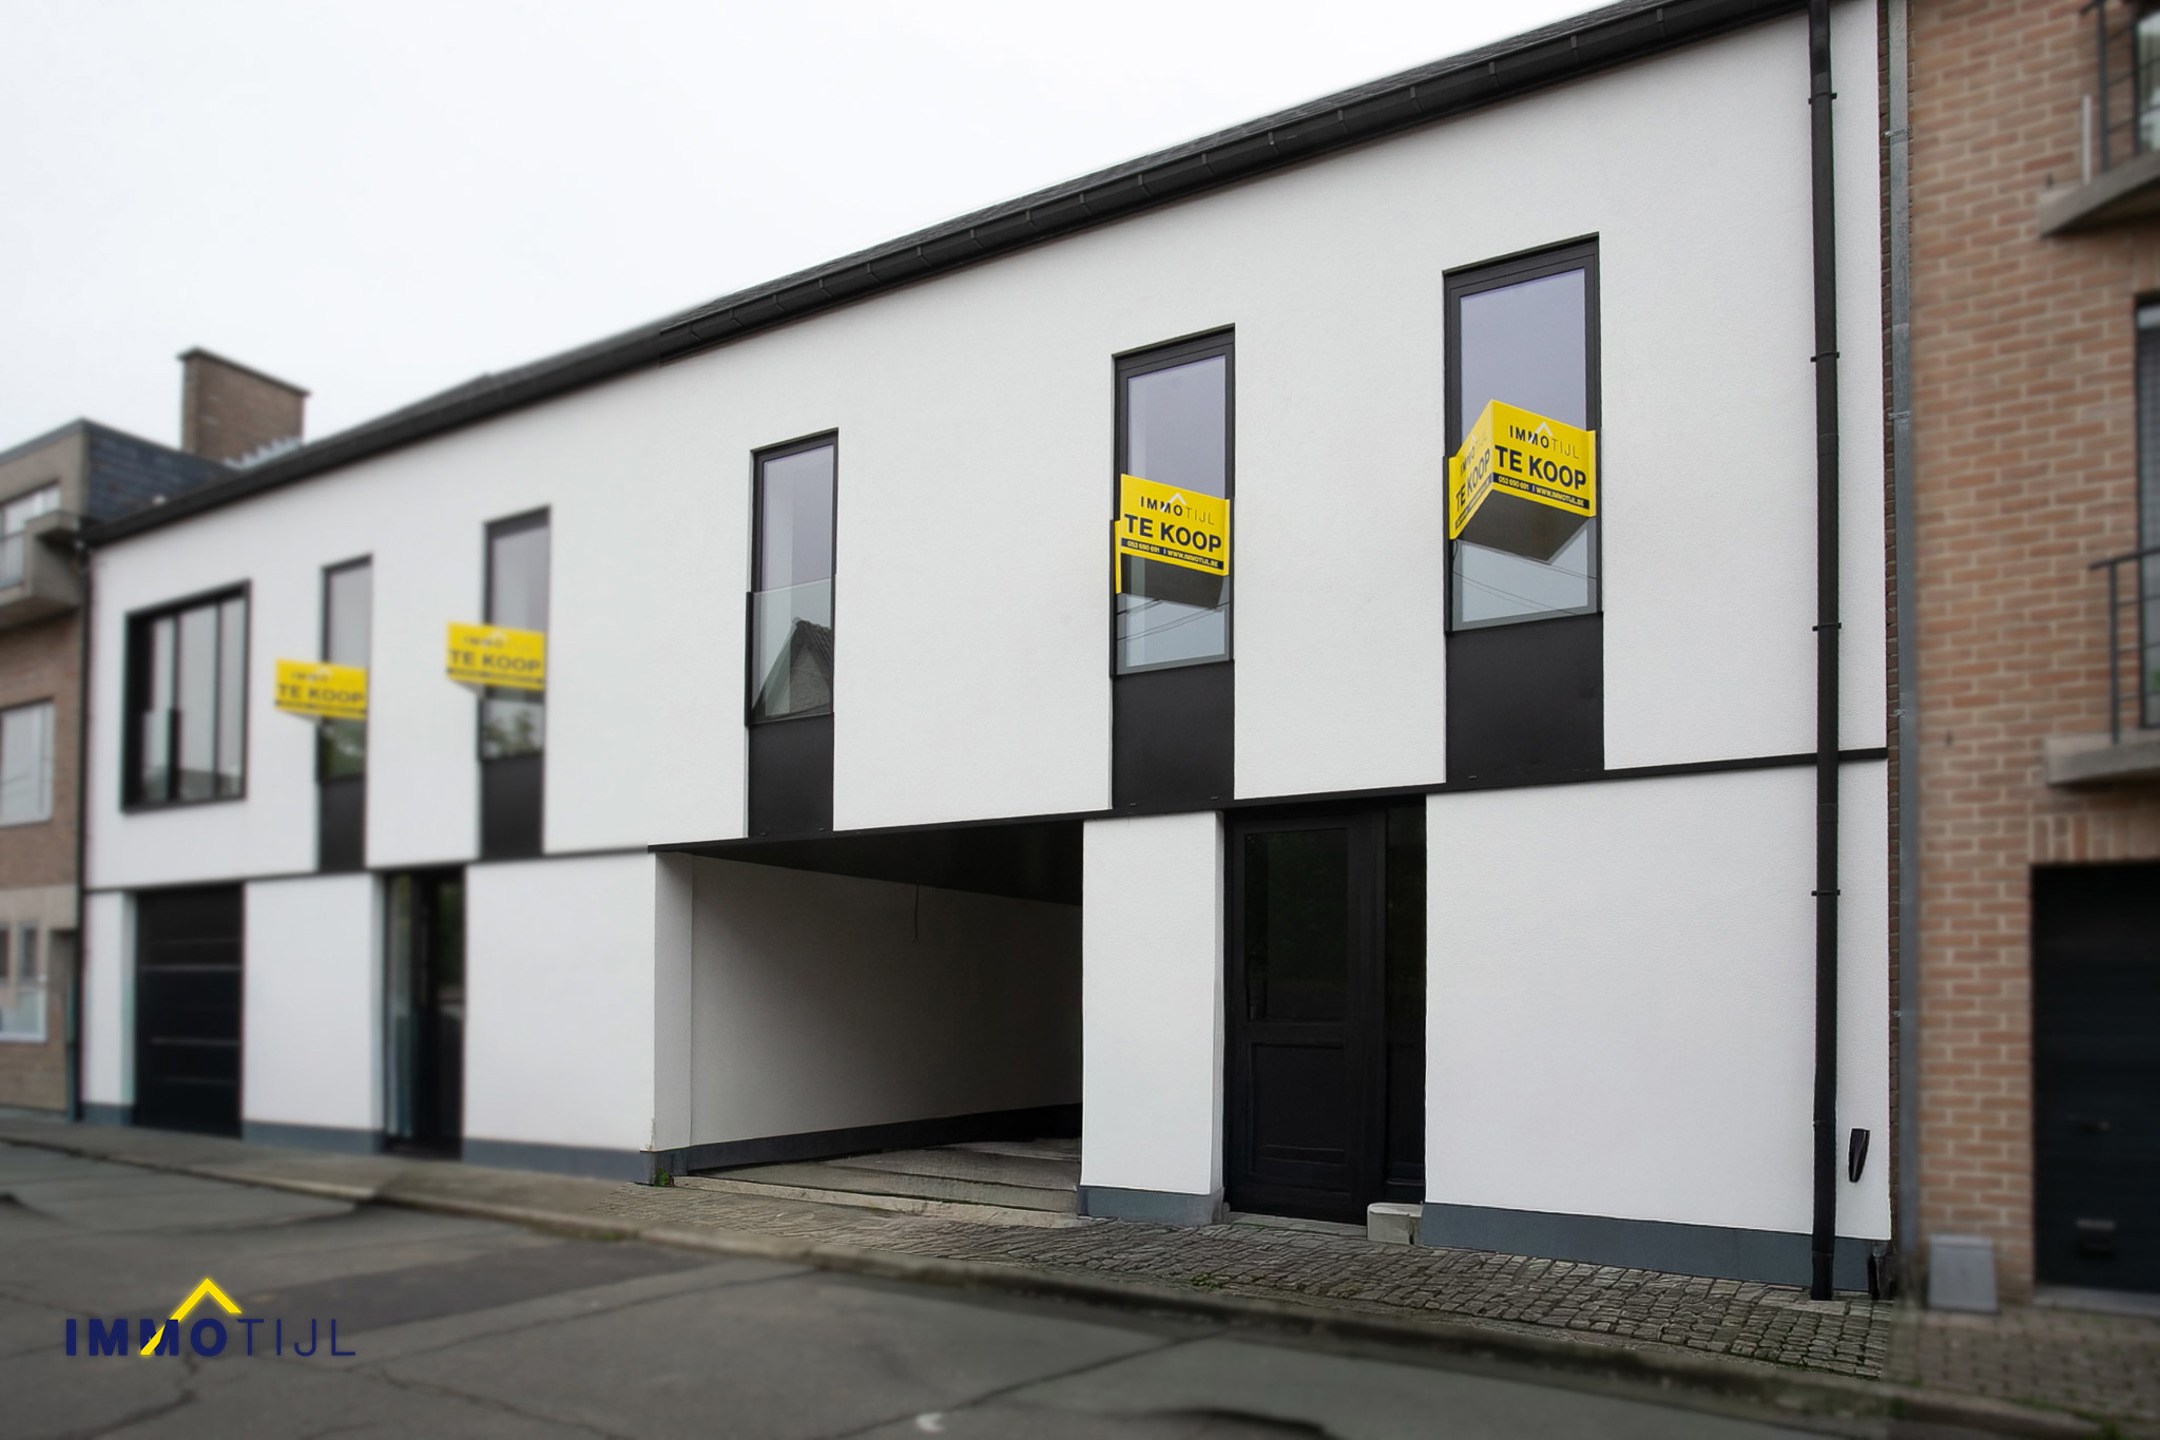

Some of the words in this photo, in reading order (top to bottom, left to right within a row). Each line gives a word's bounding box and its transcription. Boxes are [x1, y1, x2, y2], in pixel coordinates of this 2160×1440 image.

[1456, 484, 1465, 512] TE
[1466, 448, 1490, 497] KOOP
[1494, 445, 1522, 473] TE
[1529, 455, 1586, 490] KOOP
[1124, 514, 1153, 538] TE
[1161, 522, 1221, 552] KOOP
[451, 649, 475, 667] TE
[482, 653, 541, 671] KOOP
[278, 682, 300, 698] TE
[308, 687, 364, 703] KOOP
